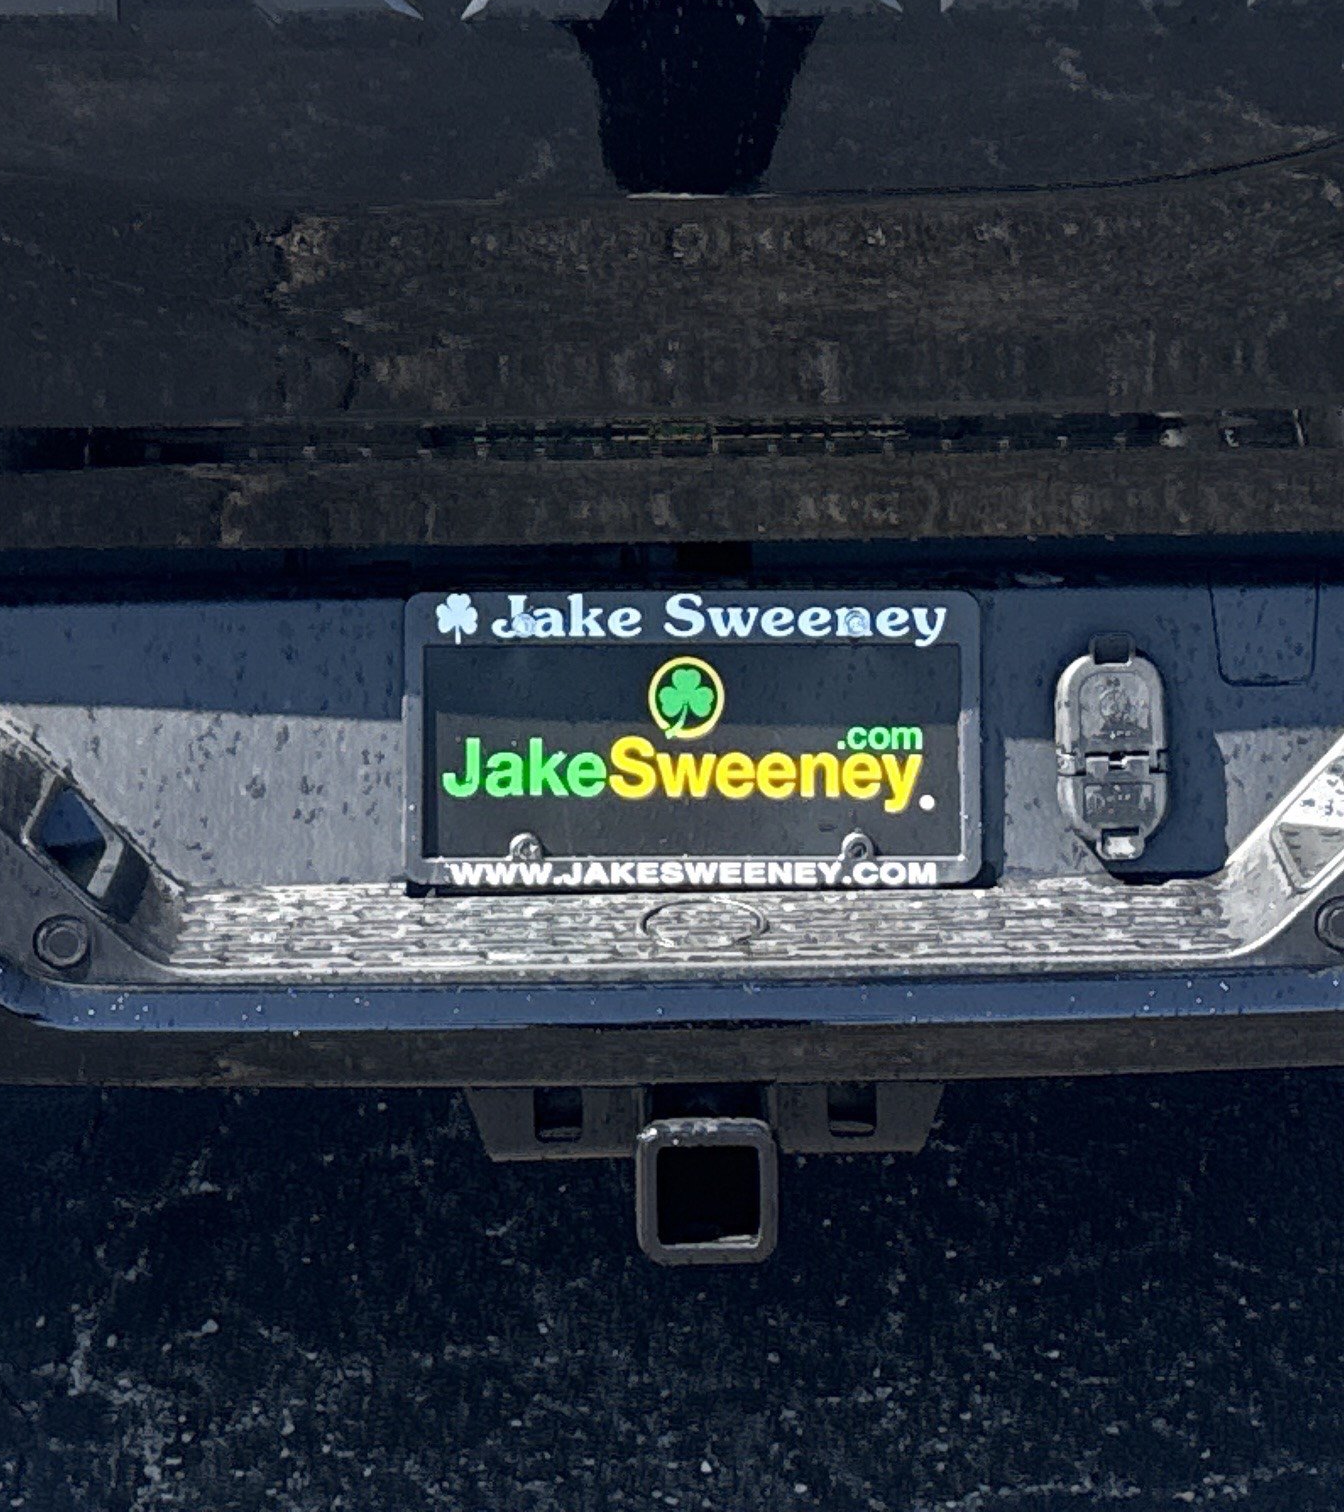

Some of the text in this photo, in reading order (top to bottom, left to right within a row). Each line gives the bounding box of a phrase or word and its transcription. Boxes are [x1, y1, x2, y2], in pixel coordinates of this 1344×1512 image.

[490, 592, 947, 647] Jake Sweeney
[449, 860, 939, 887] WWW.JAKESWEENEY.COM
